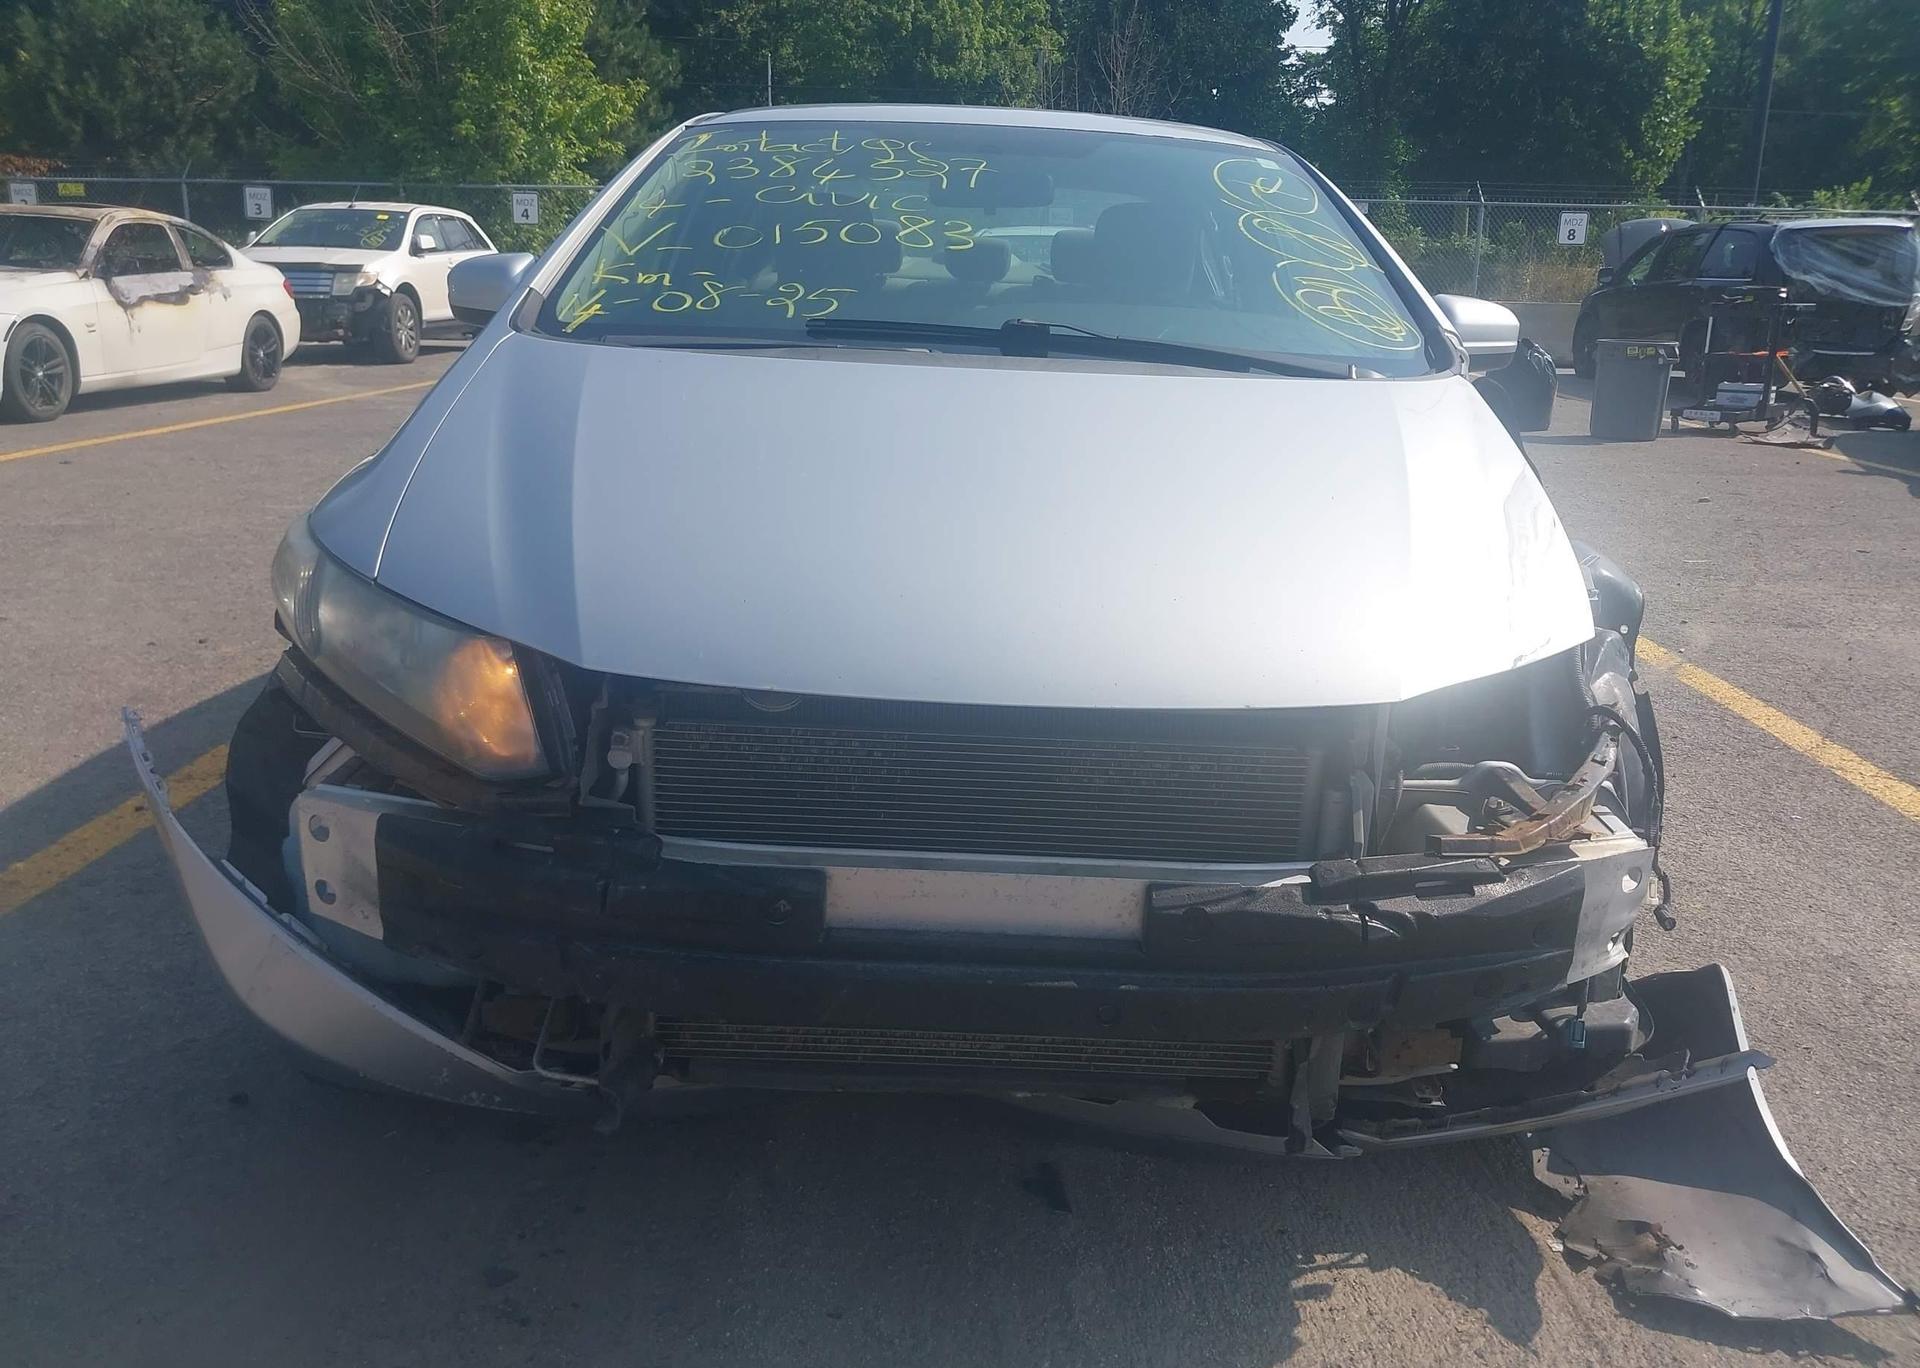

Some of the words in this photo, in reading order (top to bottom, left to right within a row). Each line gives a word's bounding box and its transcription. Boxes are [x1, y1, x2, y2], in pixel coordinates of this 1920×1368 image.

[254, 203, 263, 215] 3
[521, 208, 530, 220] 4
[1564, 217, 1584, 227] MDZ
[713, 215, 975, 250] 015083
[1567, 228, 1577, 241] 8
